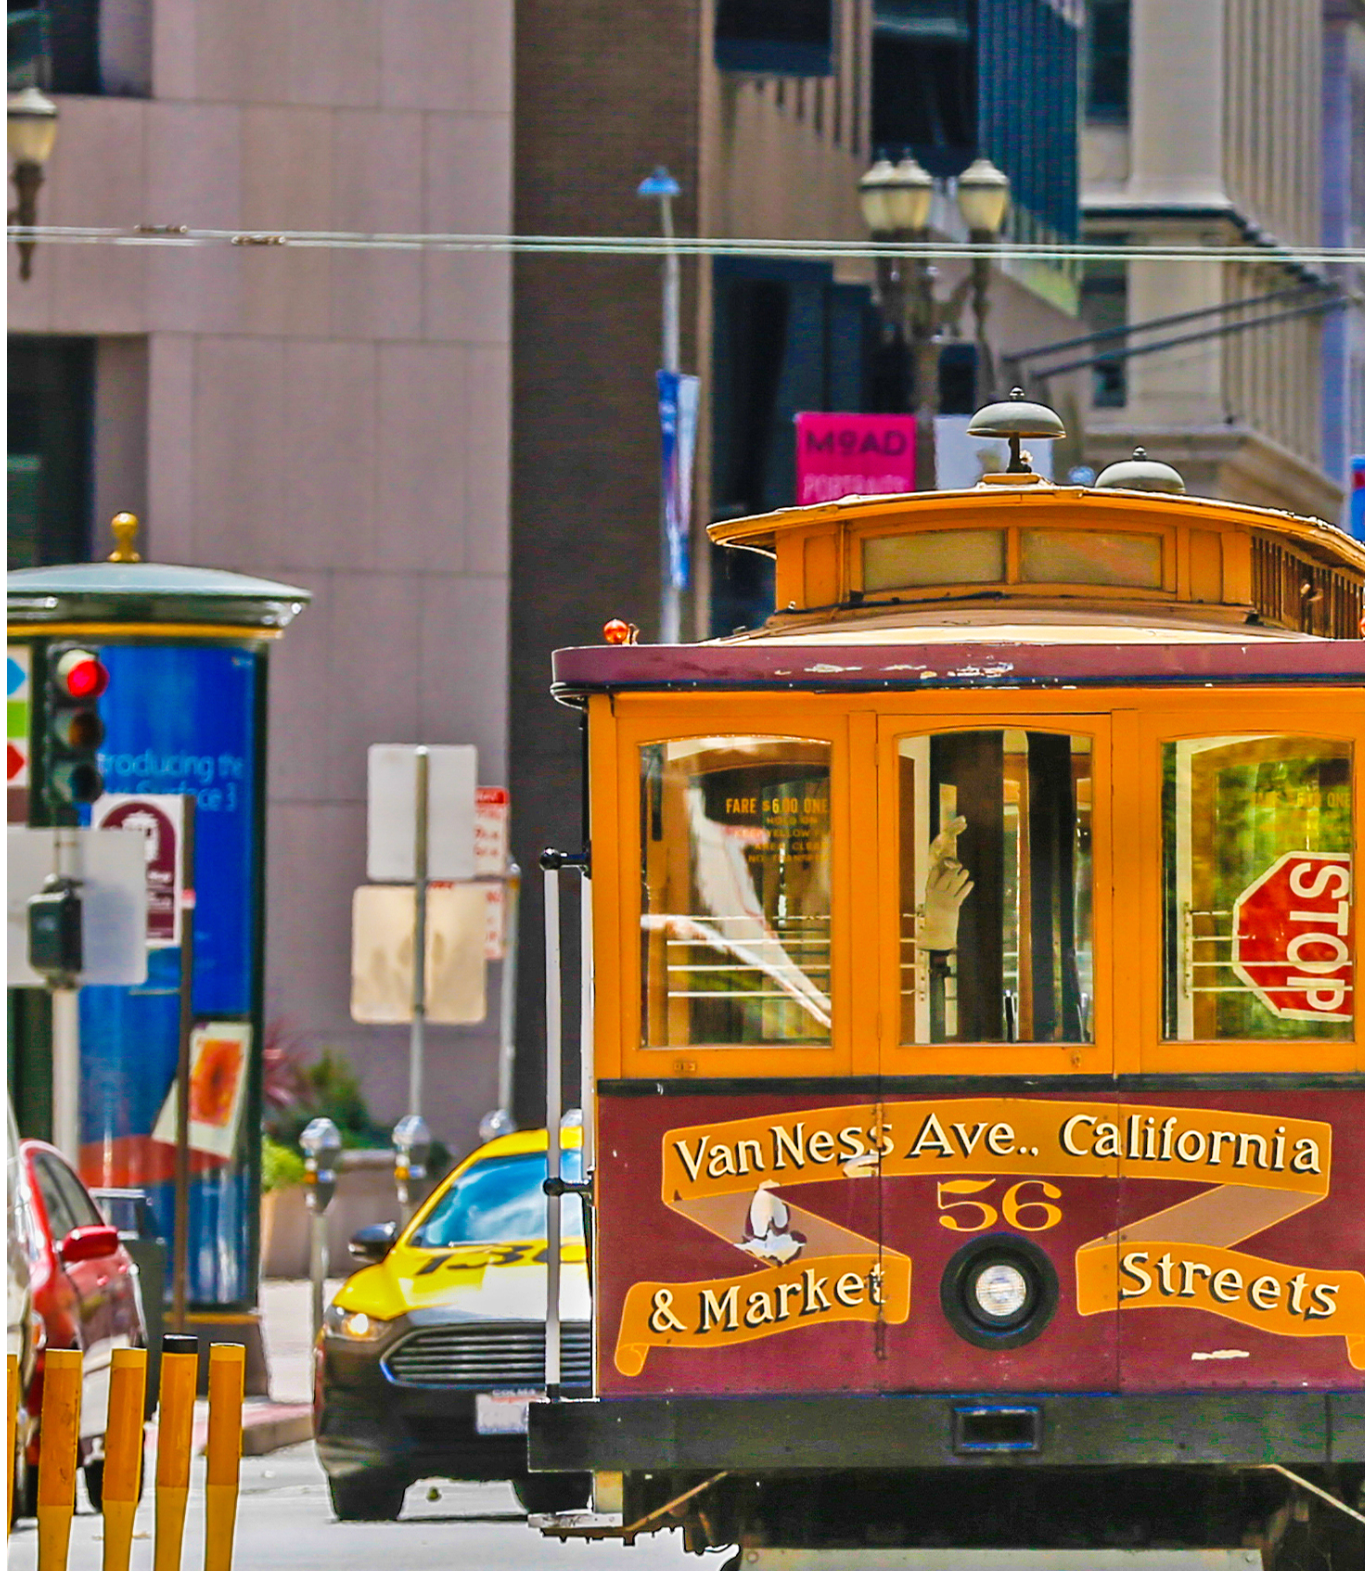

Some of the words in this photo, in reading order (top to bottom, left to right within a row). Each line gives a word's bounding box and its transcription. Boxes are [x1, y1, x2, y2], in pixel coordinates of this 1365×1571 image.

[726, 798, 757, 814] FARE
[1286, 862, 1350, 1011] STOP
[675, 1135, 765, 1182] Van
[769, 1120, 895, 1169] Ness
[1059, 1114, 1323, 1174] California
[937, 1179, 1062, 1232] 56
[650, 1288, 688, 1333] &
[700, 1263, 887, 1330] Market
[1117, 1251, 1341, 1320] Streets
